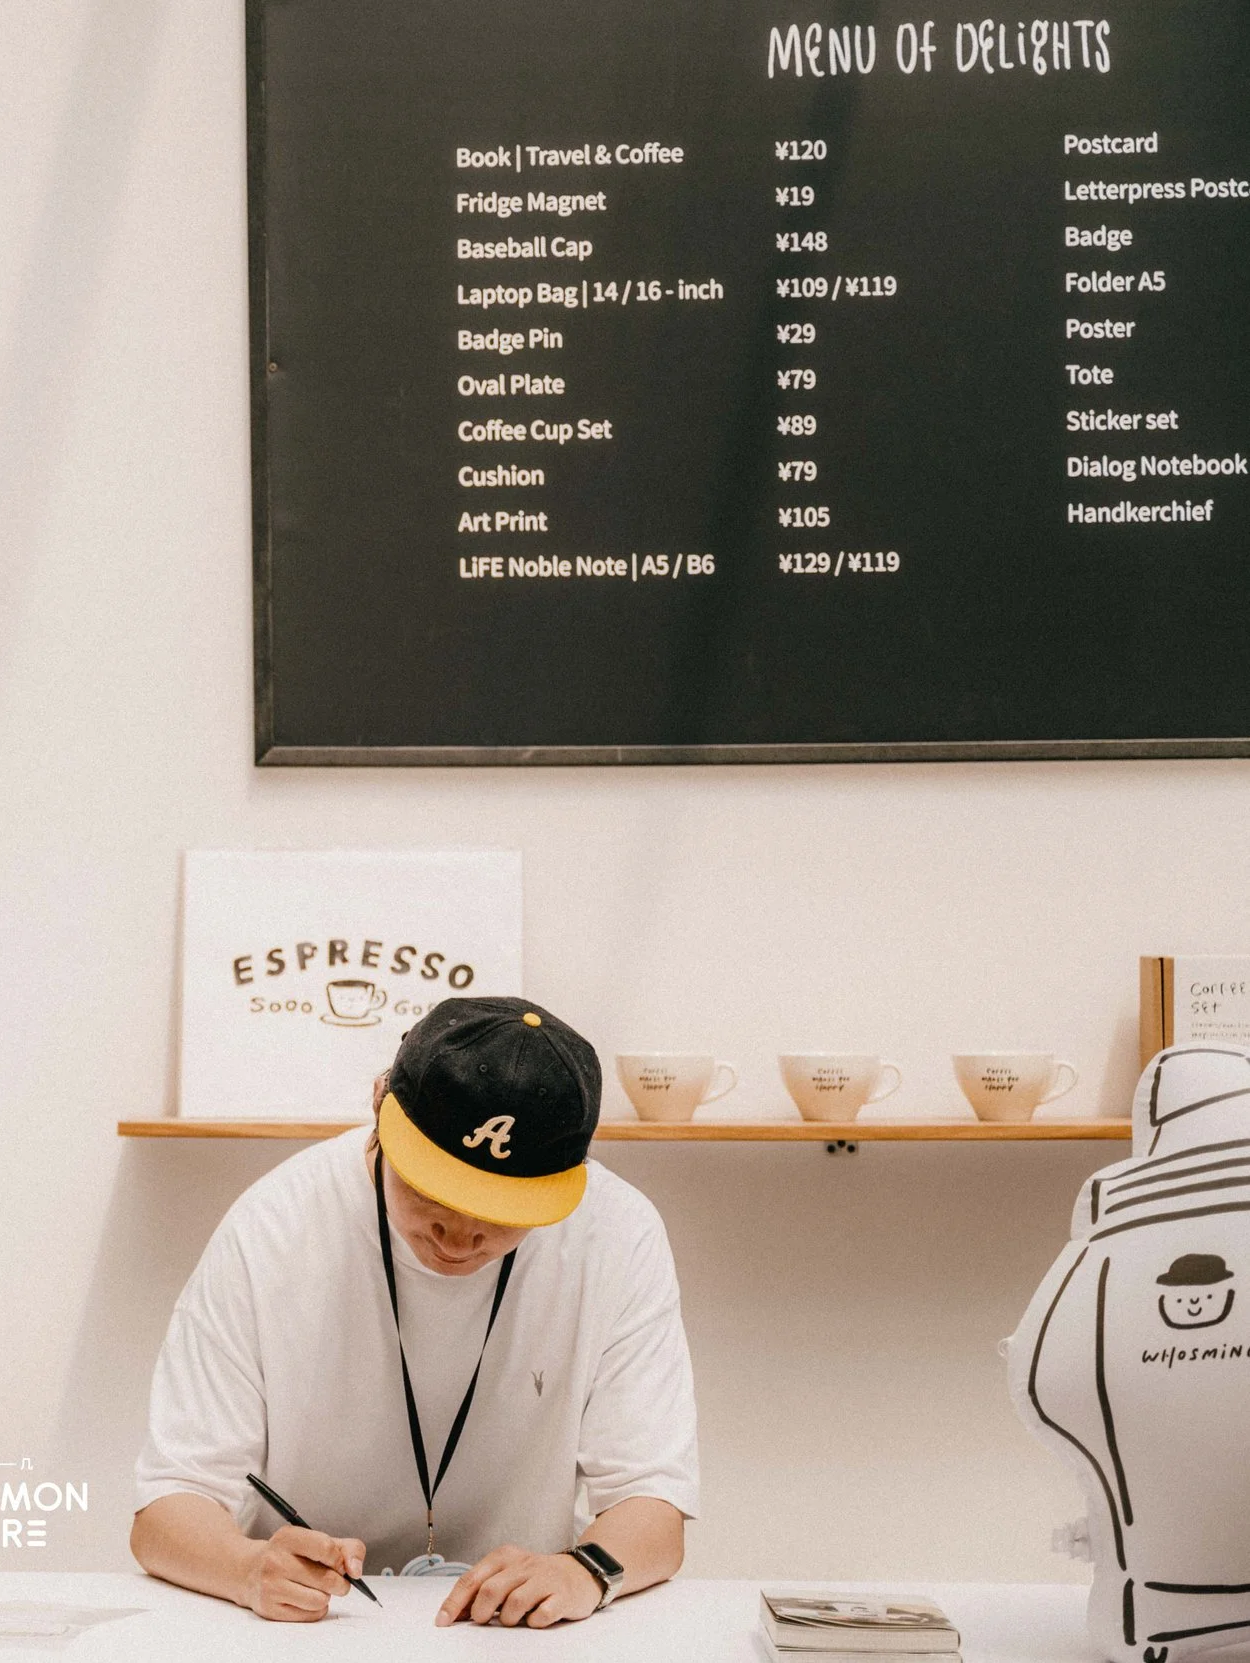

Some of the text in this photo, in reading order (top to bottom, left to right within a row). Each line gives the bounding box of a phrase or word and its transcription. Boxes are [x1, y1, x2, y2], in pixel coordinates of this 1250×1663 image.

[768, 23, 876, 79] MENU
[775, 140, 827, 161] ¥120
[1064, 131, 1159, 155] Postcard
[457, 145, 511, 168] Book
[526, 144, 591, 167] Travel
[594, 144, 612, 165] &
[615, 142, 685, 165] Coffee
[775, 186, 815, 207] ¥19
[1064, 178, 1250, 204] Letterpress Postc
[457, 191, 607, 218] Fridge Magnet
[457, 236, 593, 262] Baseball Cap
[776, 231, 828, 252] ¥148
[1065, 225, 1133, 251] Badge
[777, 277, 828, 298] ¥109
[846, 276, 898, 297] ¥119
[1066, 270, 1166, 293] Folder A5
[458, 285, 533, 309] Laptop
[537, 283, 578, 308] Bag
[593, 282, 619, 303] 14
[637, 281, 661, 302] 16
[678, 278, 724, 301] inch
[777, 323, 816, 344] ¥29
[1066, 318, 1136, 339] Poster
[458, 328, 563, 355] Badge Pin
[458, 374, 566, 397] Oval Plate
[777, 369, 817, 390] ¥79
[1066, 364, 1114, 385] Tote
[777, 415, 817, 436] ¥89
[1067, 409, 1179, 432] Sticker set
[458, 419, 613, 446] Coffee Cup Set
[458, 465, 545, 488] Cushion
[778, 461, 818, 482] ¥79
[1067, 453, 1249, 482] Dialog Notebook
[458, 510, 549, 533] Art Print
[779, 507, 831, 528] ¥105
[1067, 499, 1215, 523] Handkerchief
[509, 555, 572, 578] Noble
[576, 555, 627, 577] Note
[641, 554, 670, 576] A5
[687, 554, 716, 575] B6
[779, 553, 830, 574] ¥129
[848, 552, 900, 573] ¥119
[233, 939, 475, 990] ESPRESSO
[462, 1114, 517, 1159] A
